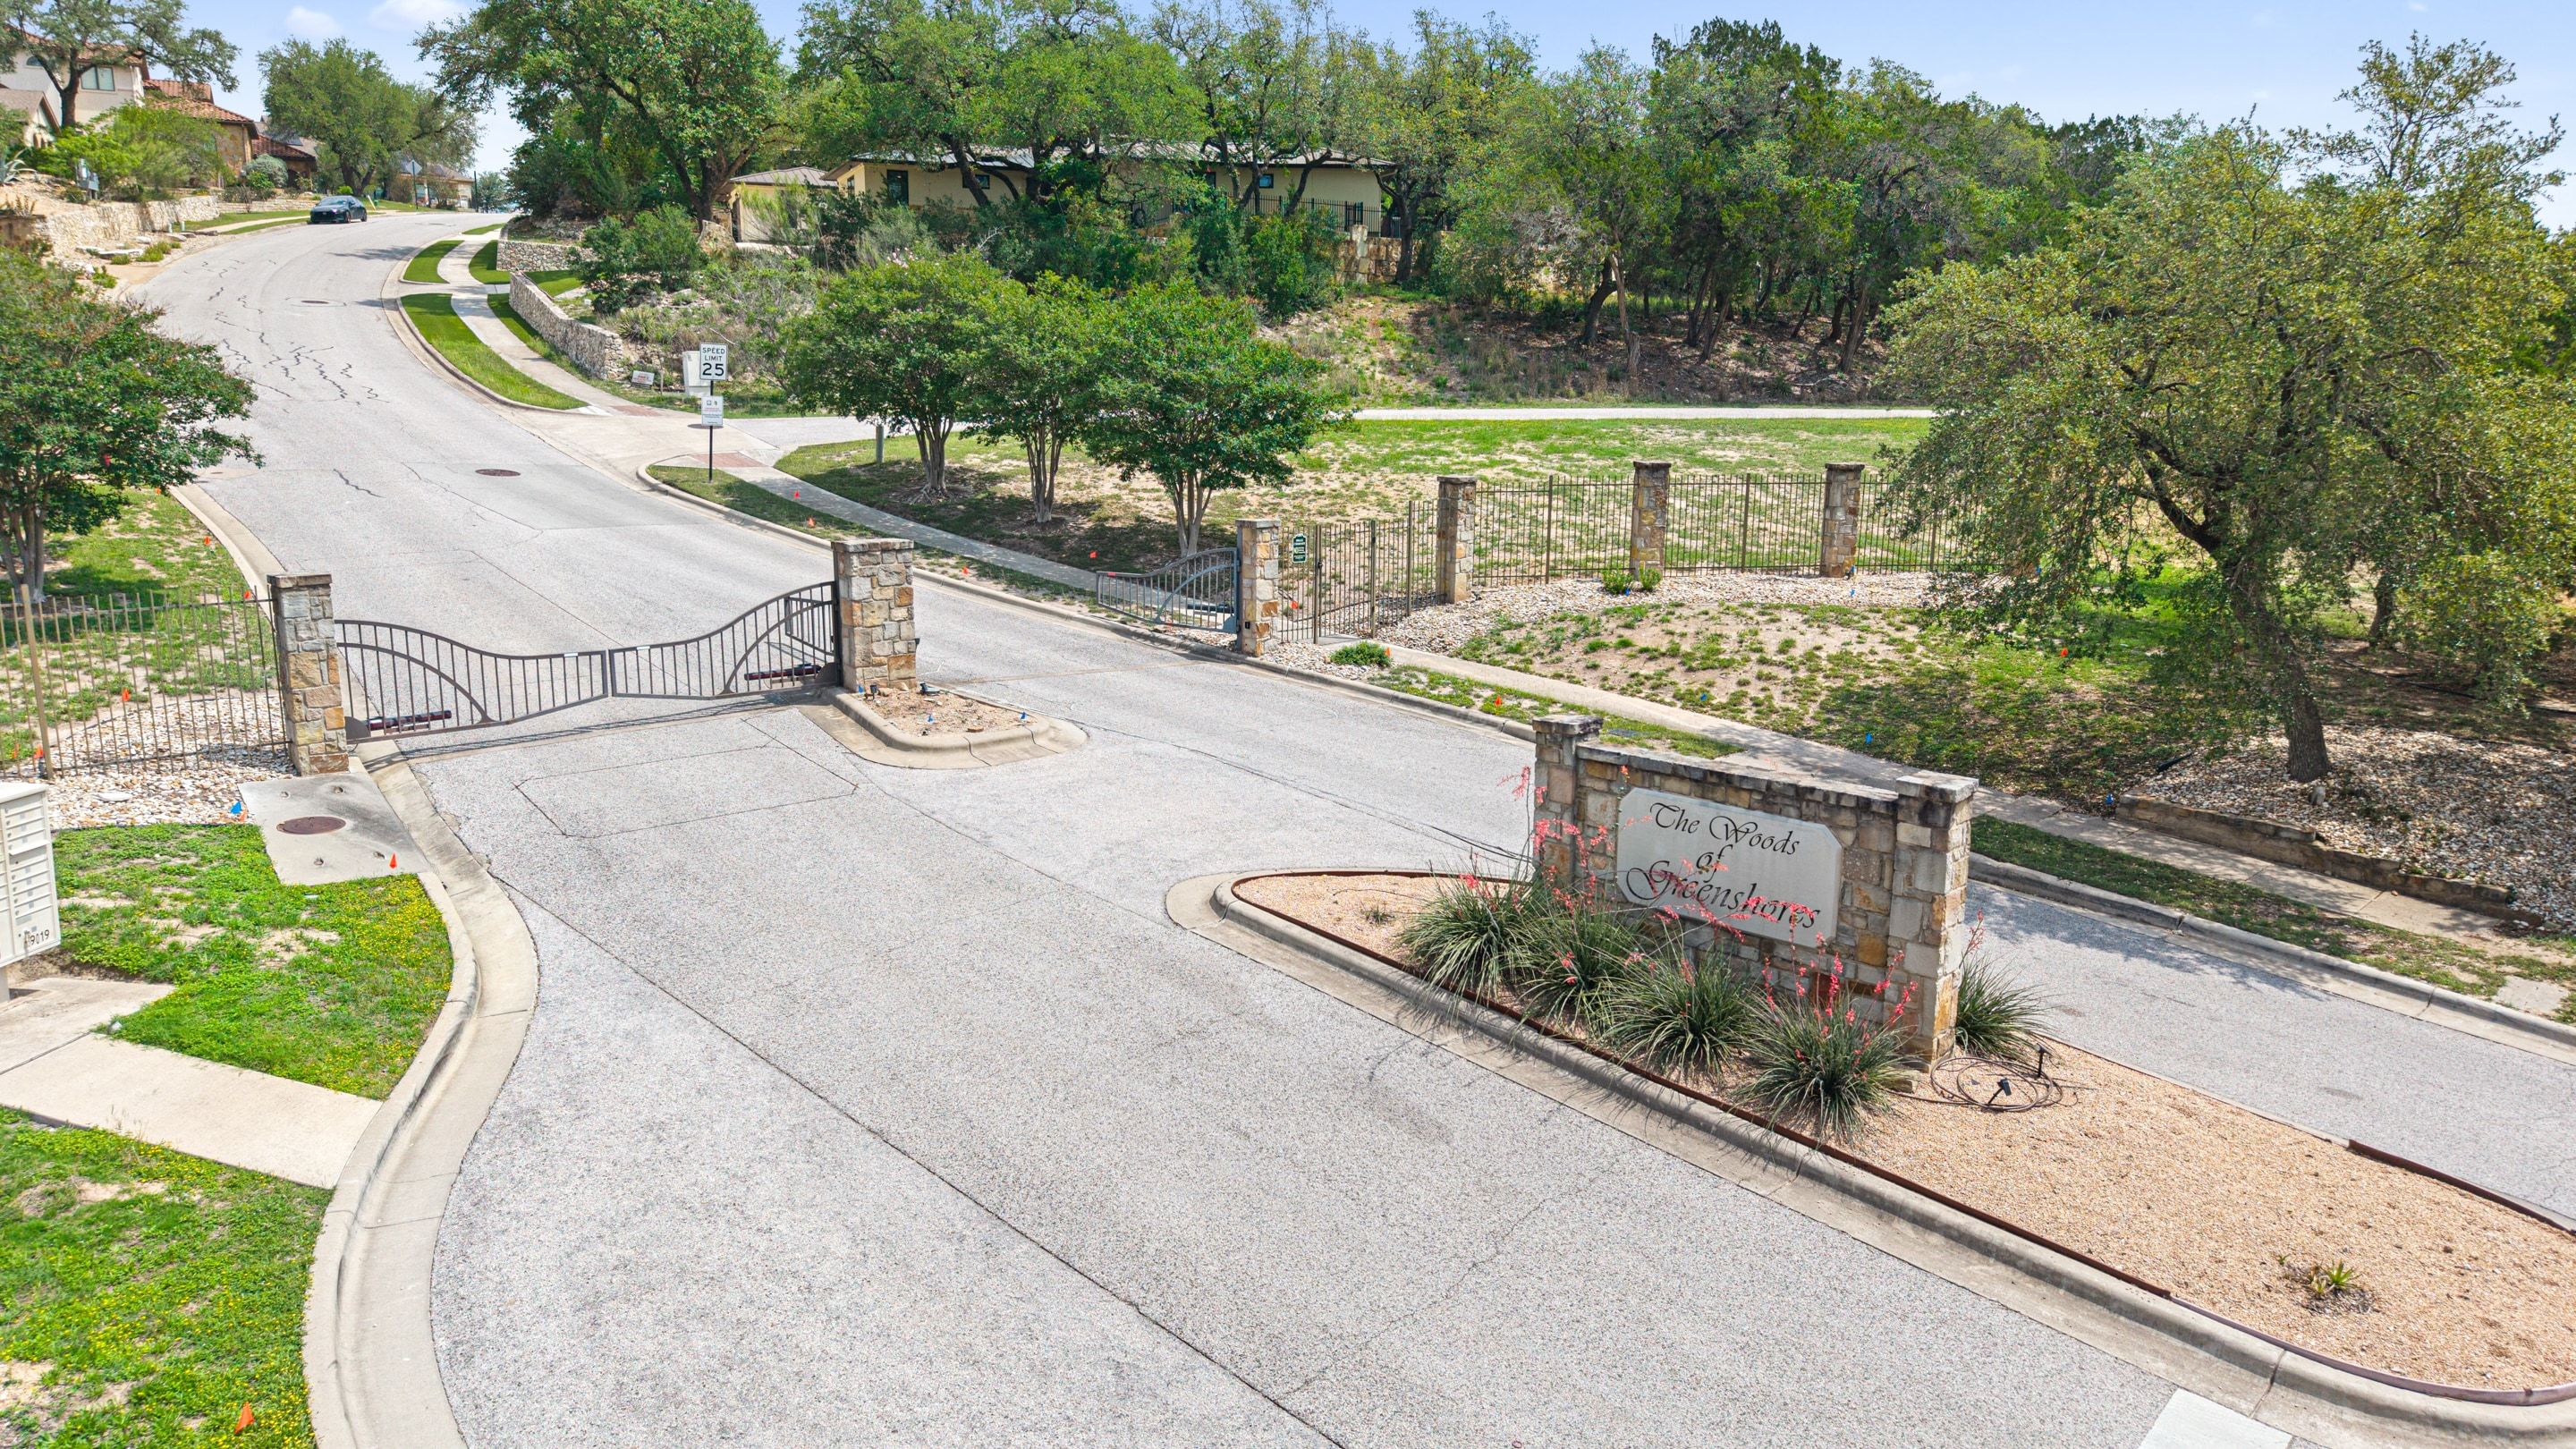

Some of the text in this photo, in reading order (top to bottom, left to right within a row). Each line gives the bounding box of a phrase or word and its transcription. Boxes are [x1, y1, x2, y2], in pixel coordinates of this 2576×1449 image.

[702, 362, 724, 377] 25
[1649, 802, 1801, 856] The Woods
[1696, 843, 1733, 883] of
[1626, 860, 1821, 928] Greenshores
